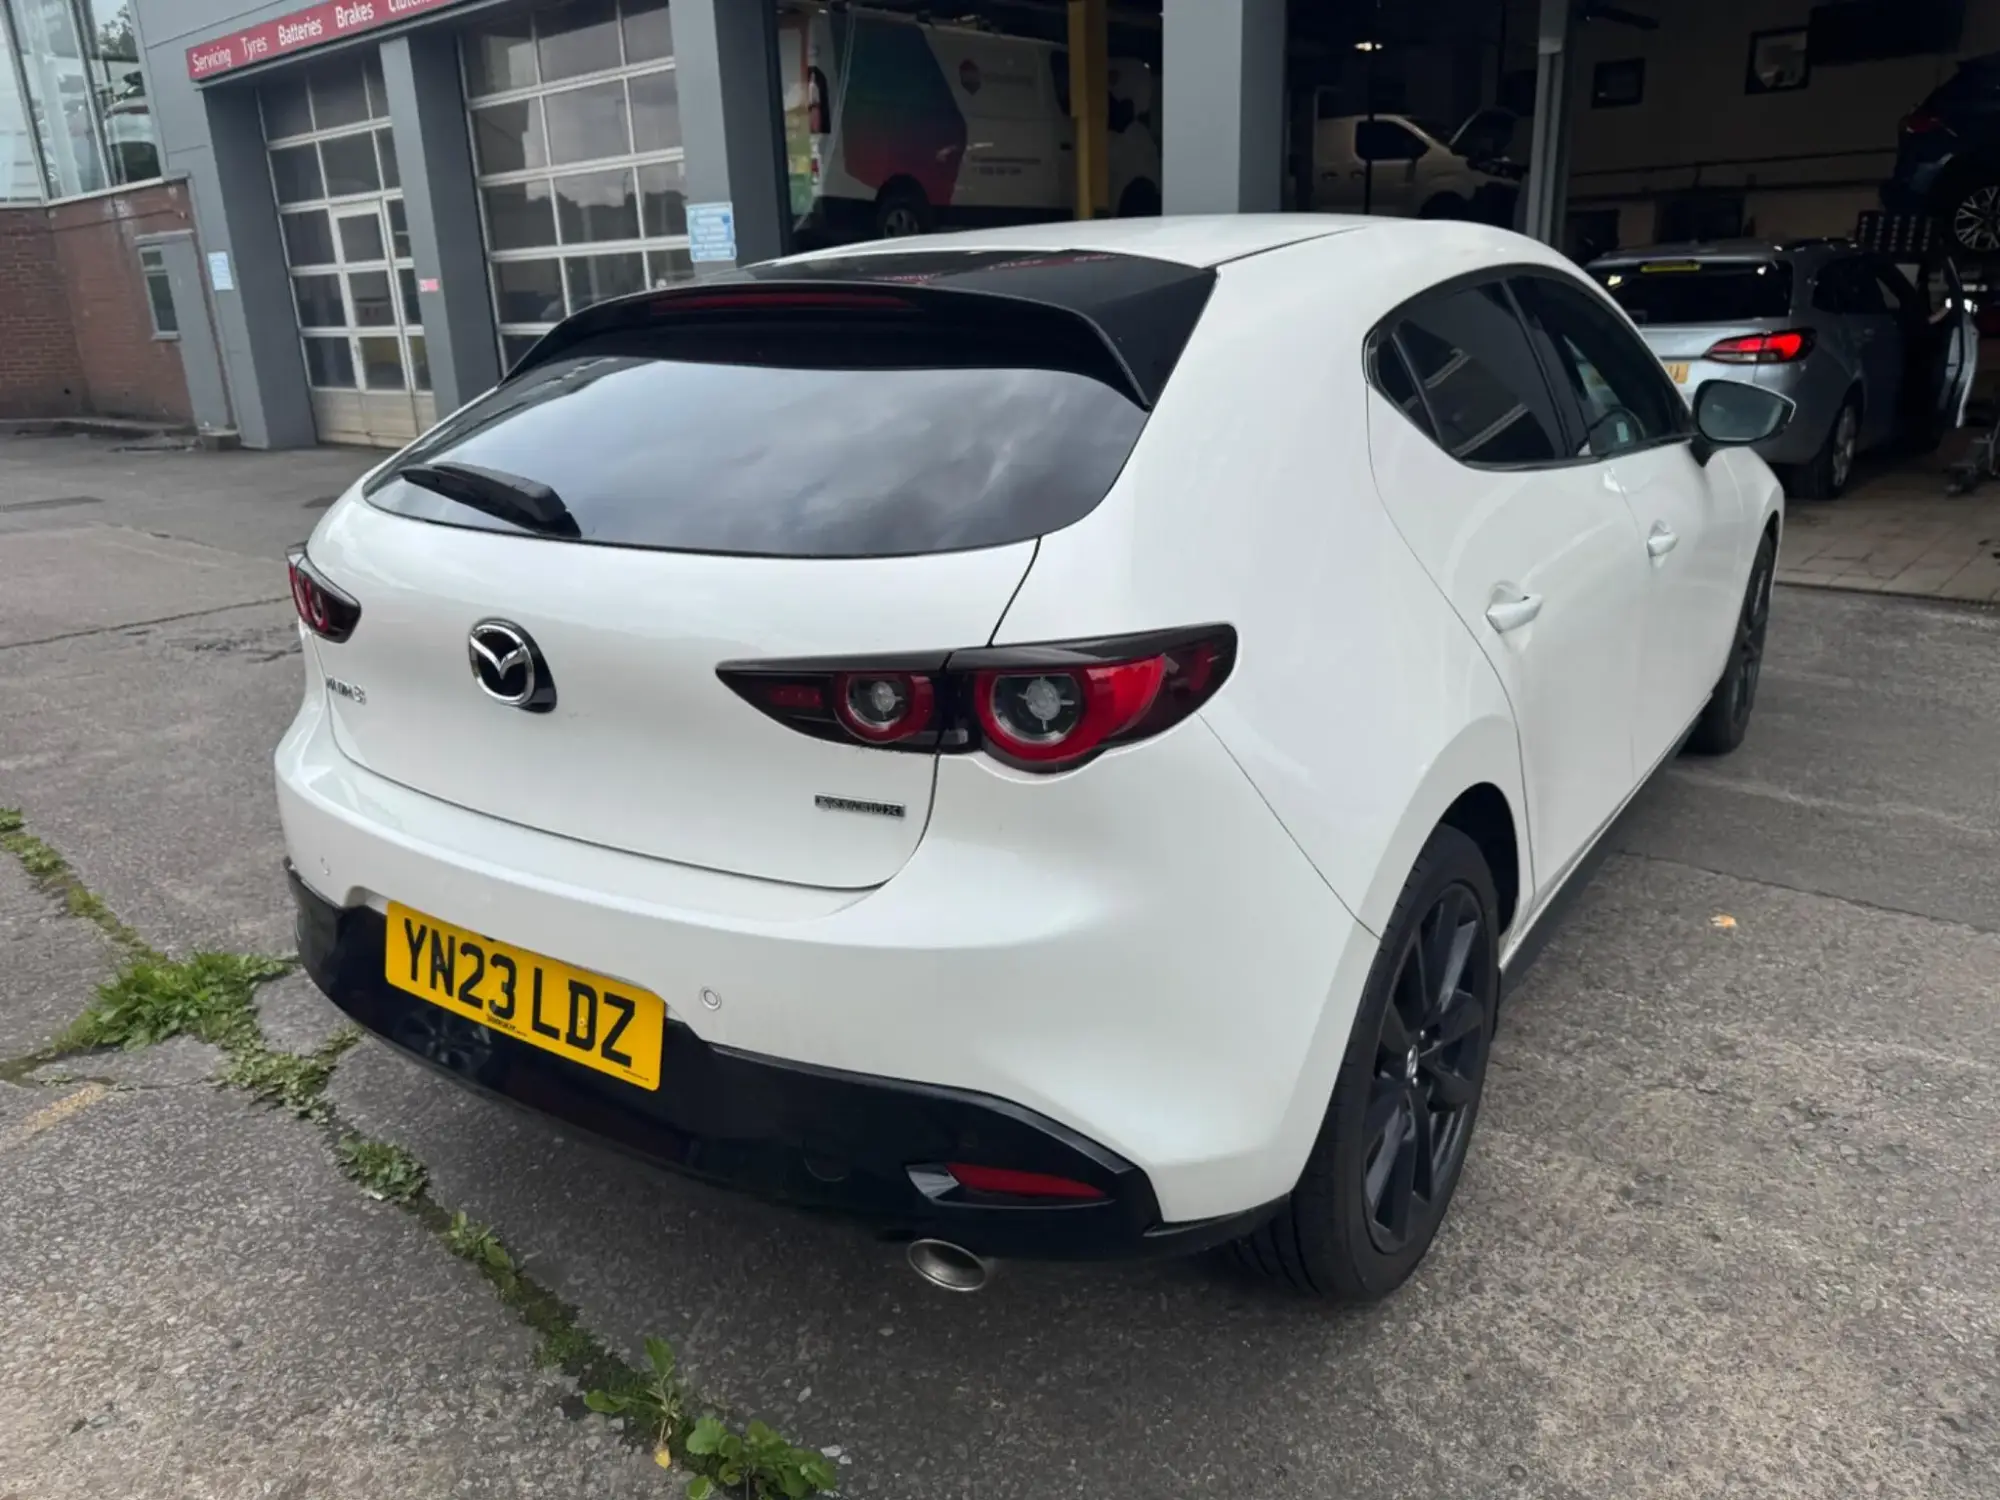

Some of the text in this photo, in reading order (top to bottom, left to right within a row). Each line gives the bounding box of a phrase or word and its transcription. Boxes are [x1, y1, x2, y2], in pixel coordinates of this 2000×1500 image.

[192, 45, 232, 72] Servicing
[240, 36, 268, 60] Tyres
[278, 16, 323, 46] Batteries
[335, 1, 375, 29] Brakes
[404, 917, 635, 1069] YN23 LDZ
